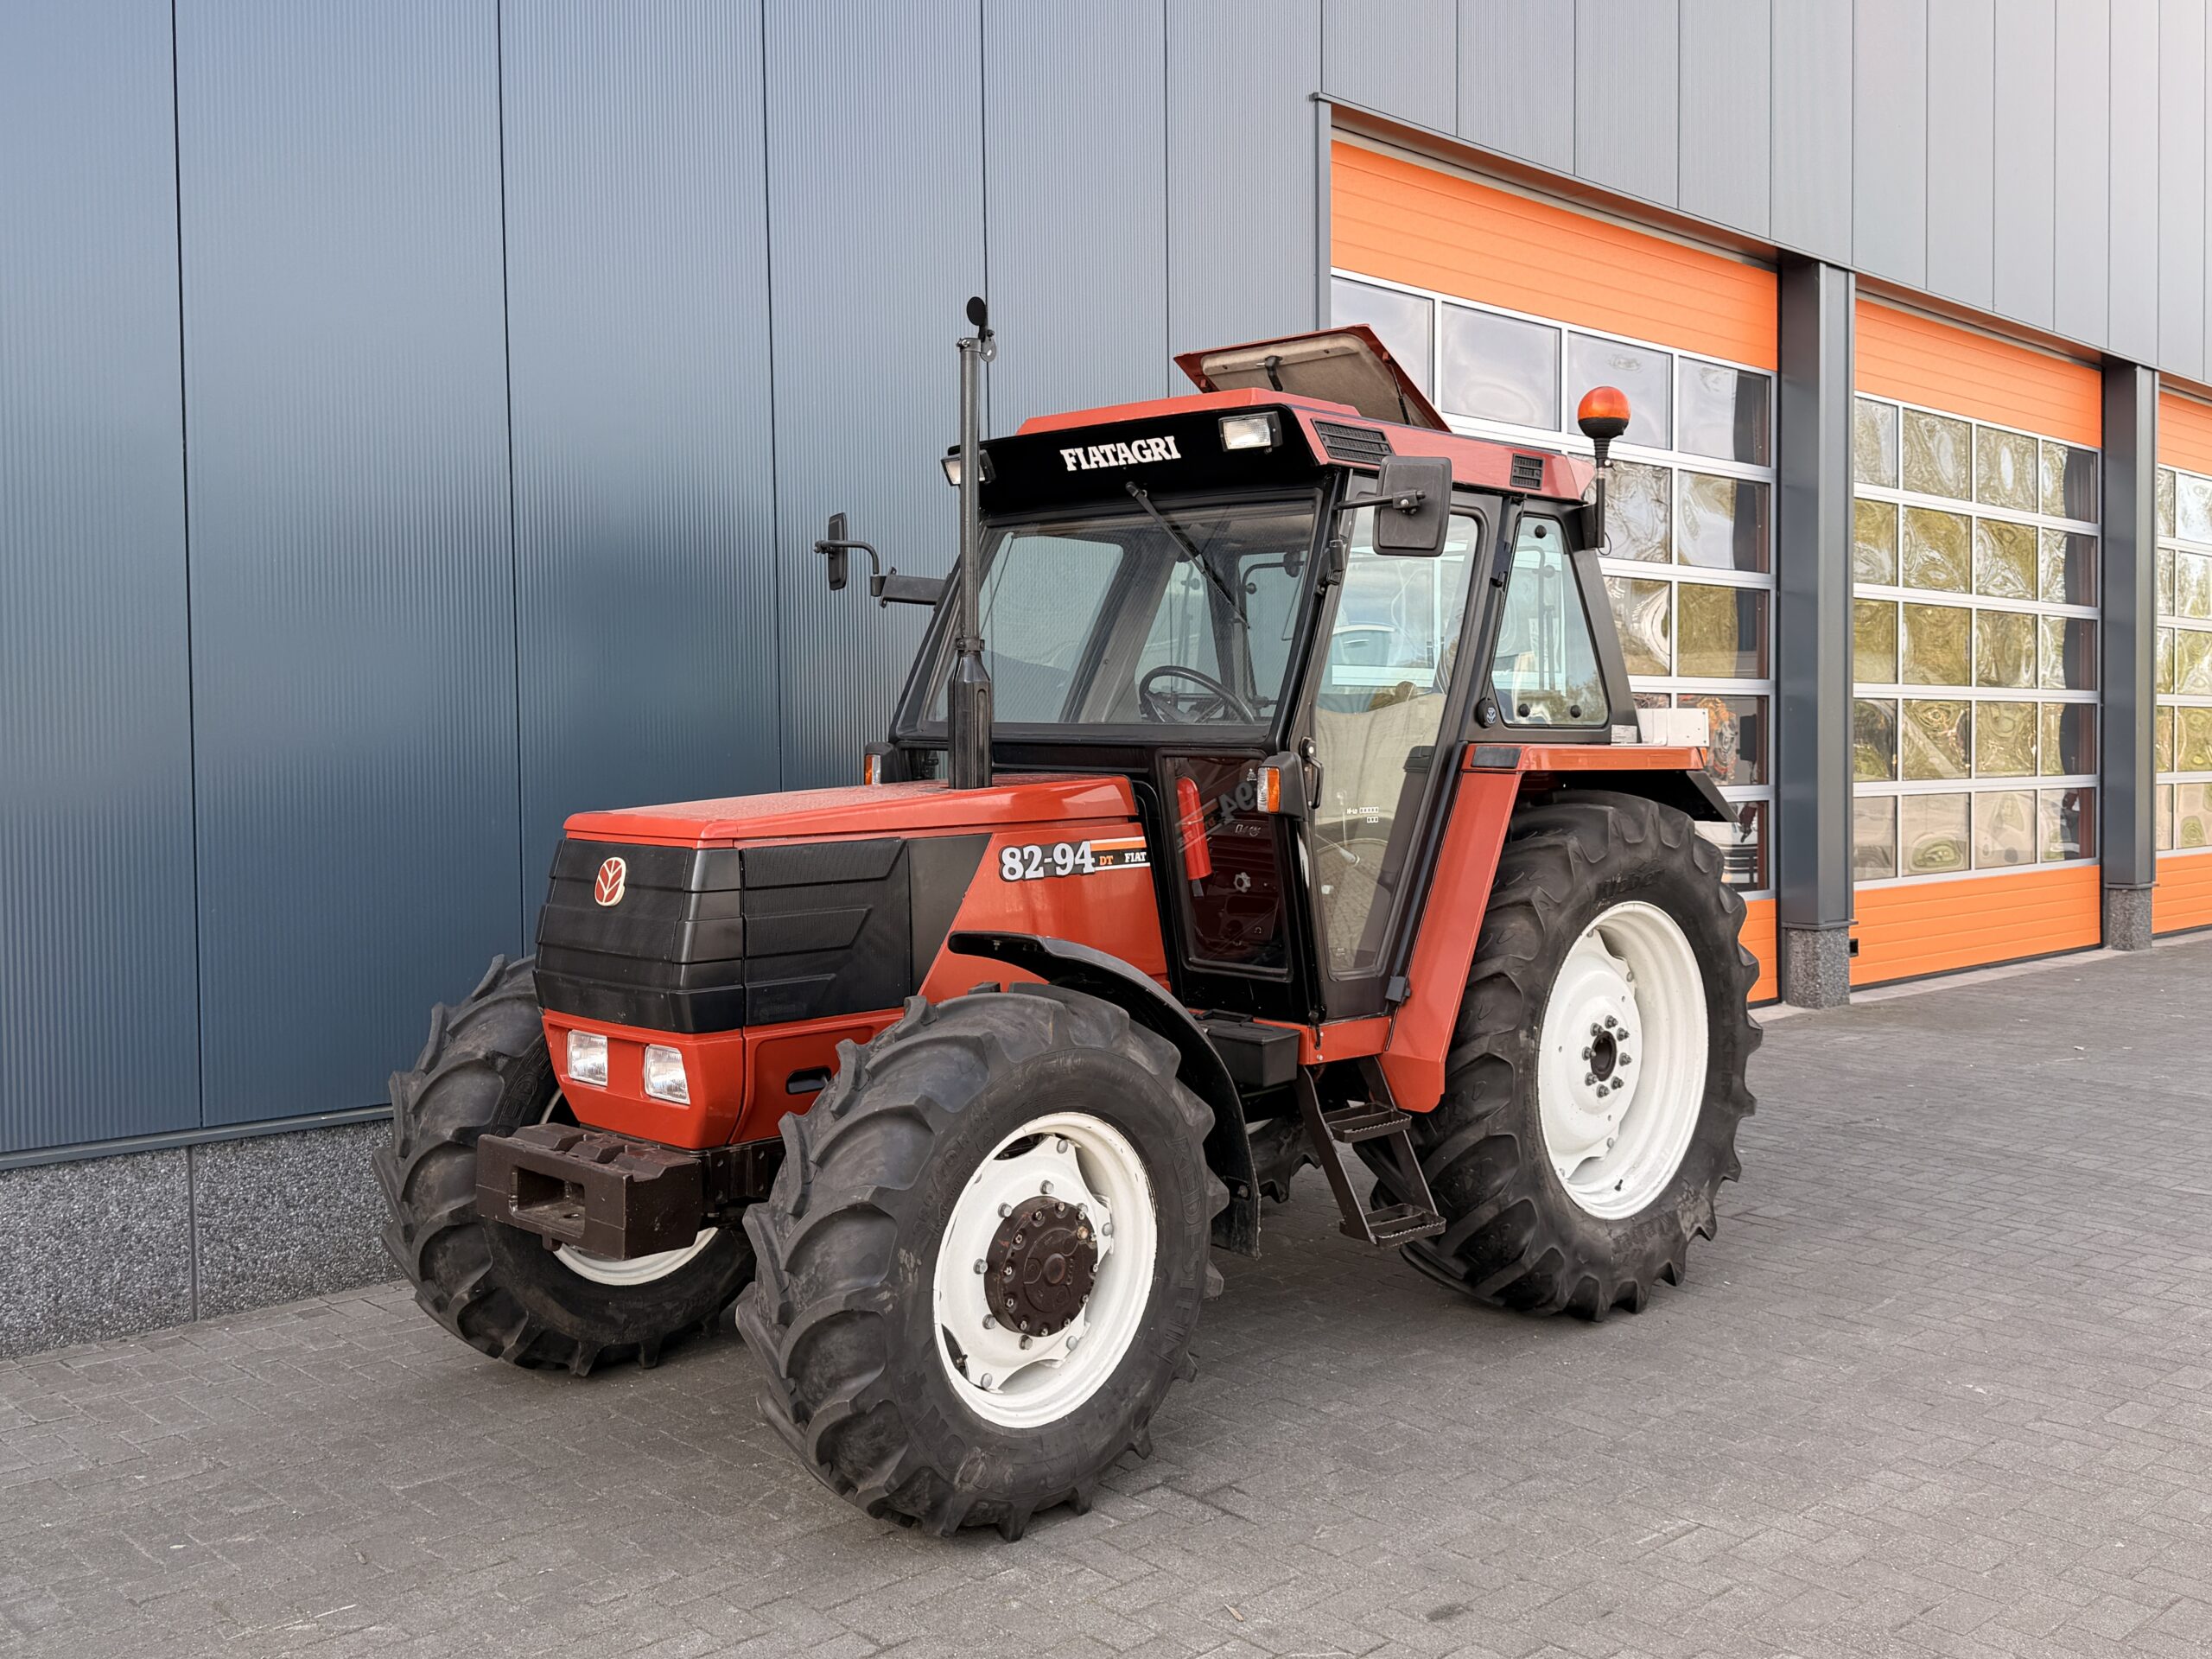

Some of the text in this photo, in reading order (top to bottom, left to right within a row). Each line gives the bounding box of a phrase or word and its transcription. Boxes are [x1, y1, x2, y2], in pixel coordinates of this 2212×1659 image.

[1059, 435, 1182, 471] FIATAGRI
[1001, 840, 1147, 880] 82-94 DT FIAT
